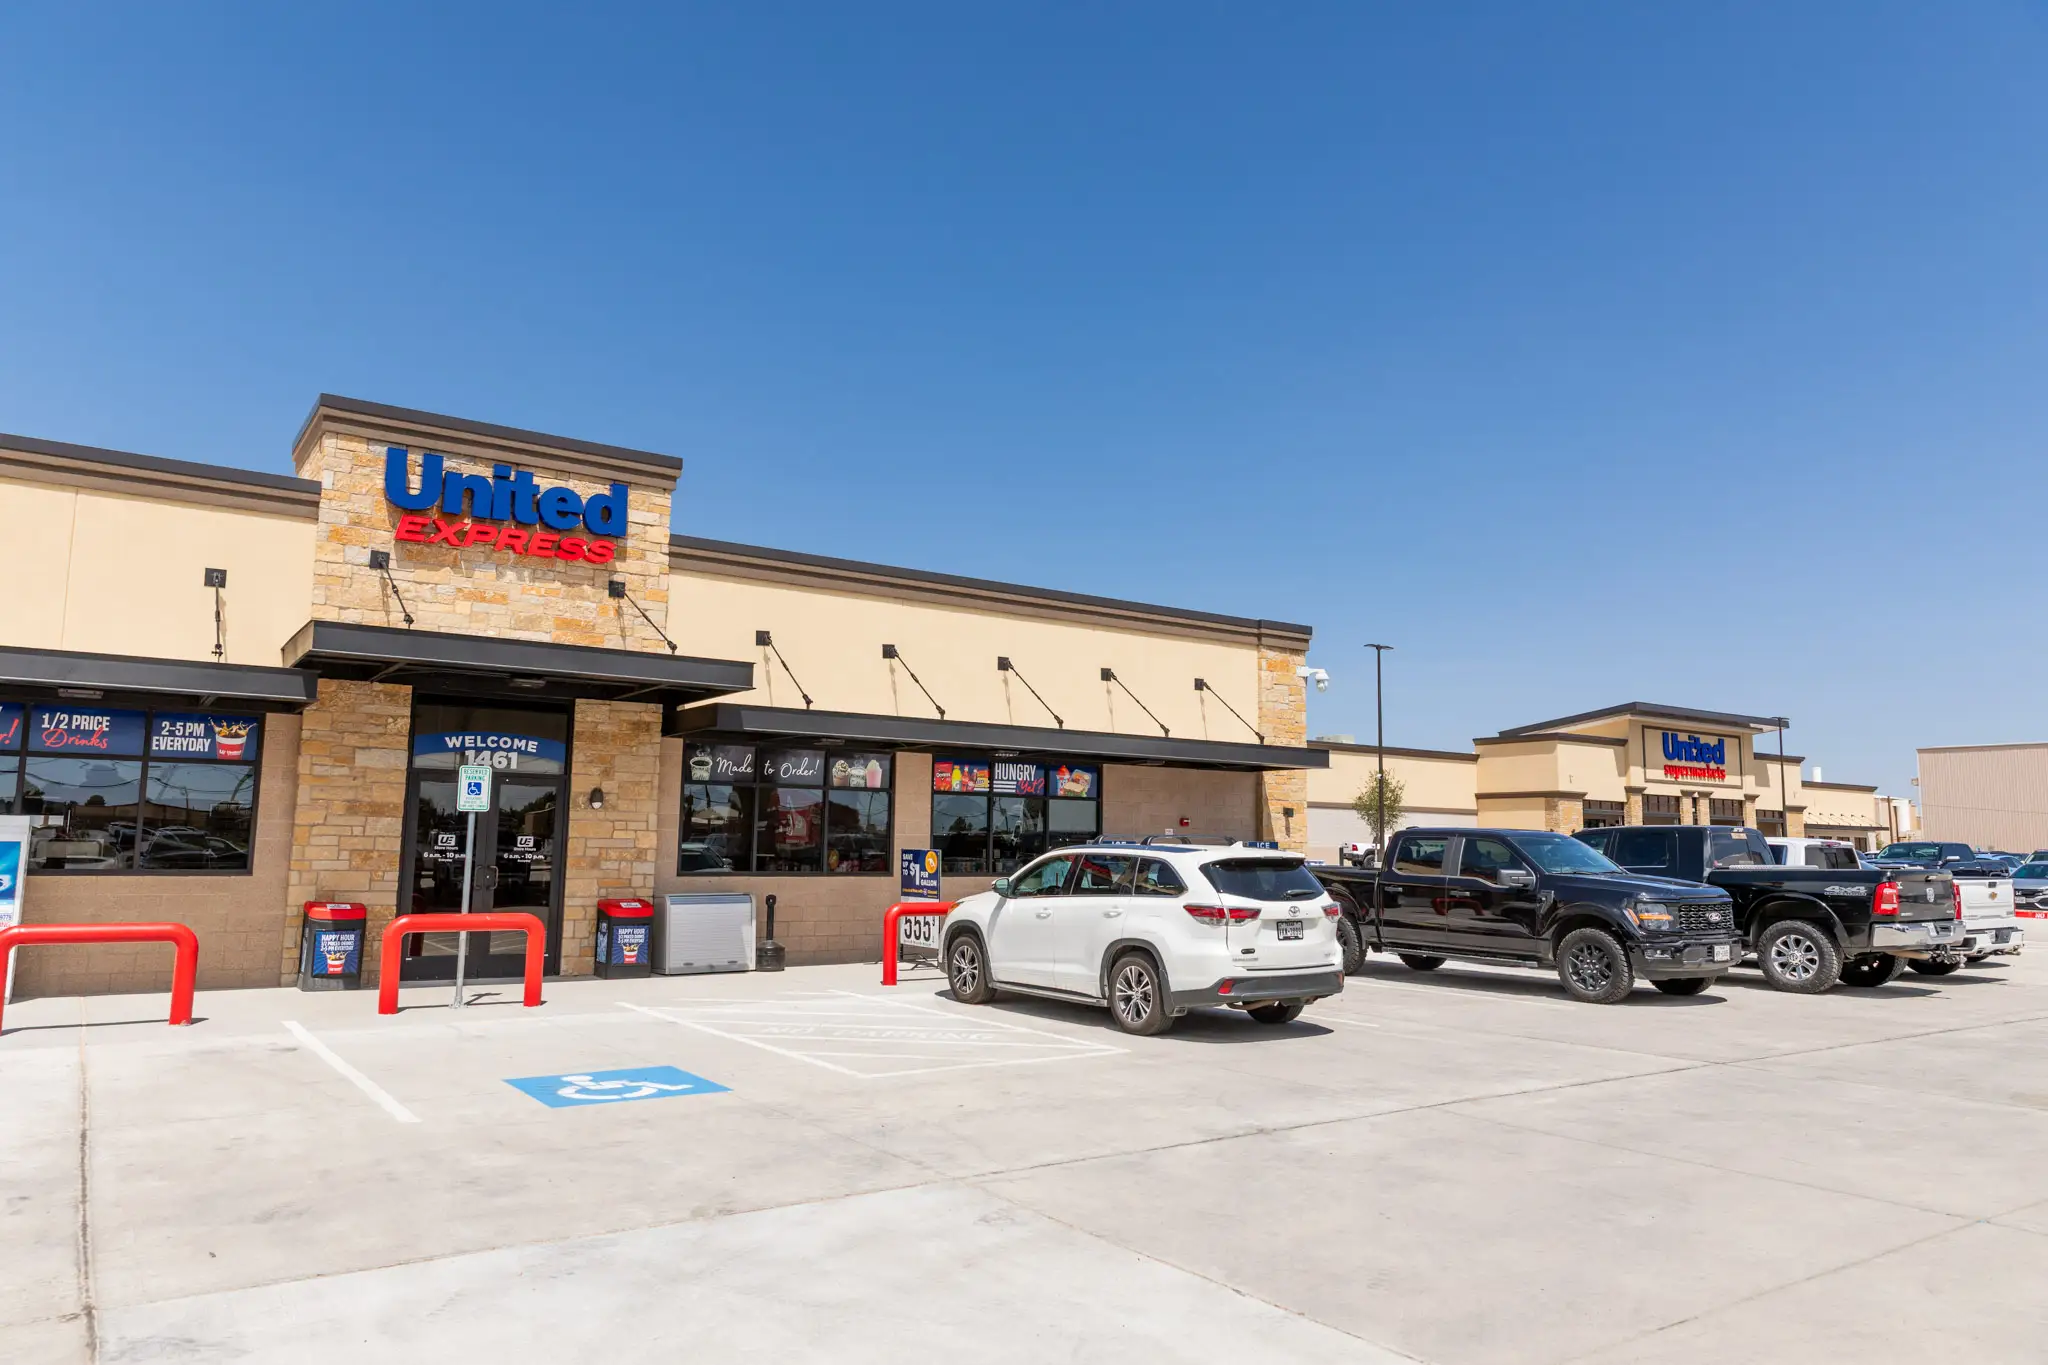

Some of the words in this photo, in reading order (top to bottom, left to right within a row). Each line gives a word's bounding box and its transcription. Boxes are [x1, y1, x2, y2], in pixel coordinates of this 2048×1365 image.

[384, 447, 629, 537] United
[394, 514, 617, 564] EXPRESS
[42, 713, 69, 730] 1/2
[72, 715, 110, 732] PRICE
[161, 721, 184, 736] 2-5
[185, 723, 205, 737] PM
[41, 726, 108, 749] Drinks
[152, 737, 211, 752] EVERYDAY
[445, 735, 538, 753] WELCOME
[1662, 732, 1725, 765] United
[465, 750, 518, 769] 1461
[716, 754, 754, 776] Made
[764, 759, 775, 776] to
[780, 759, 820, 778] Order!
[994, 762, 1036, 782] HUNGRY
[1016, 777, 1045, 795] Yet?
[902, 853, 913, 861] SAVE
[1824, 885, 1867, 893] 4x4
